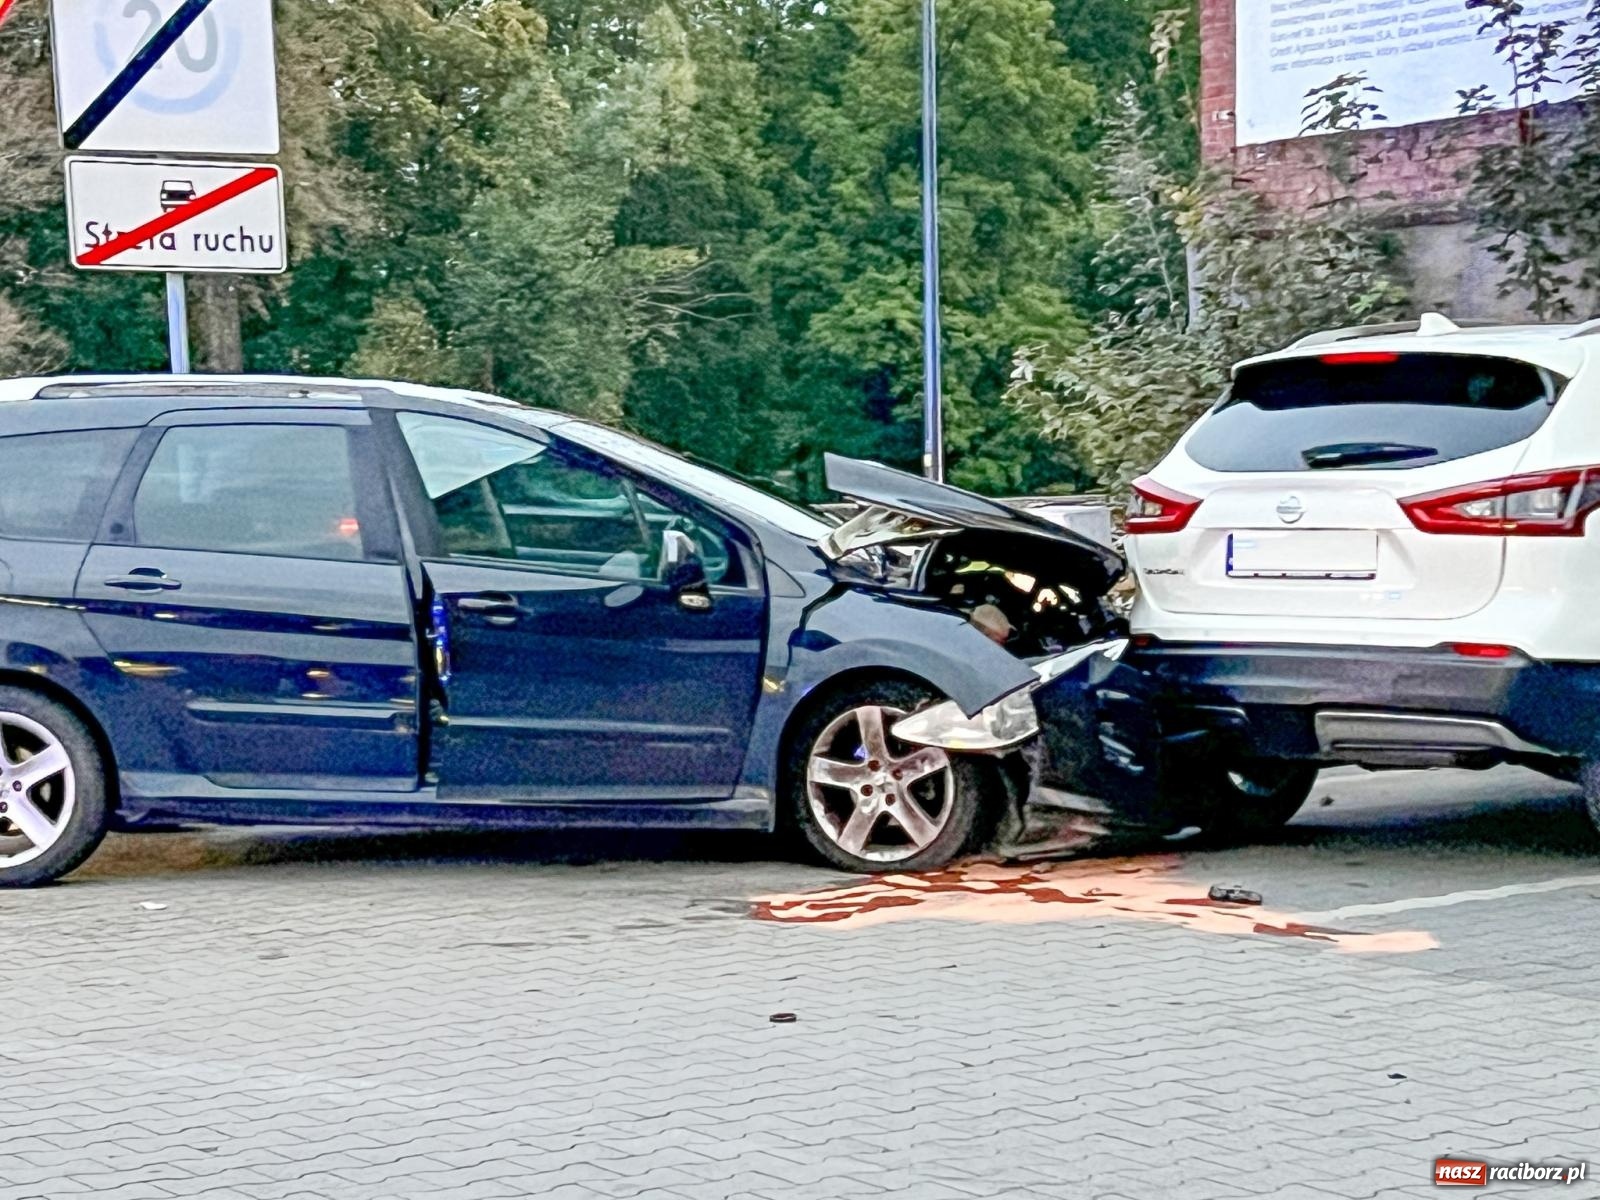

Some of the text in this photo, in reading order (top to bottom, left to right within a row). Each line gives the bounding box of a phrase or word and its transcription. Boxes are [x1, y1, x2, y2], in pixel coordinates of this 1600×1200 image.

[121, 0, 218, 73] 20
[85, 221, 273, 253] Sta ruchu
